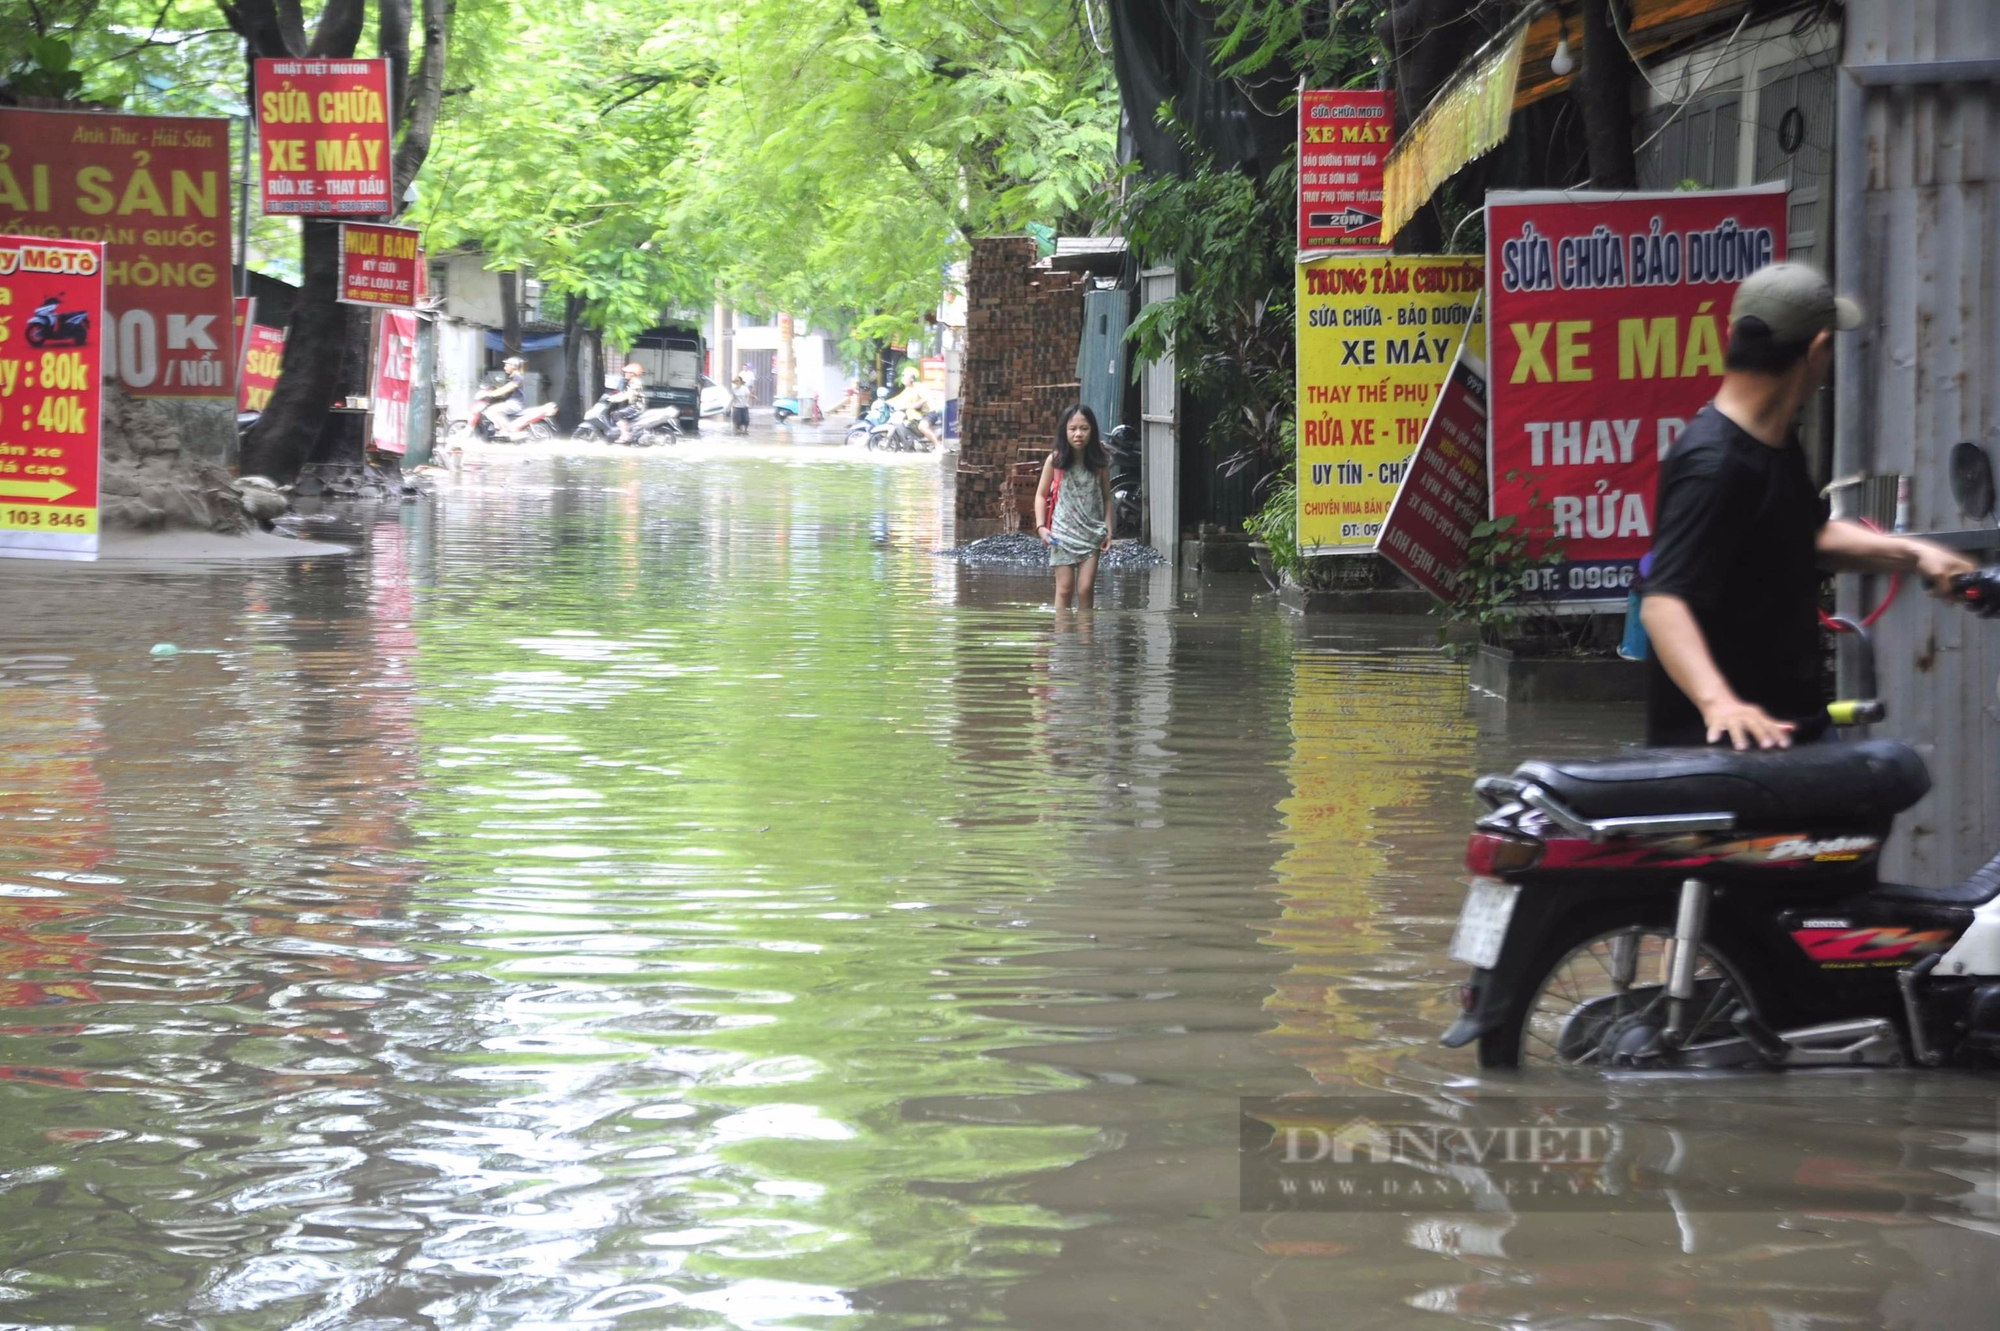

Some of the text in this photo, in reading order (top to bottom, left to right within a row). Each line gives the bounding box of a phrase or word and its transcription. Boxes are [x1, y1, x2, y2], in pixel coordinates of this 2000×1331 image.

[330, 63, 369, 74] MOTOR
[262, 81, 385, 123] SỬA CHỮA
[1357, 107, 1383, 118] MOTO
[1305, 121, 1392, 143] XE MÁY
[267, 133, 382, 171] XE MÁY
[1344, 156, 1360, 166] THAY
[0, 144, 217, 218] ẢI SẢN
[268, 175, 294, 195] RỬA
[297, 180, 315, 195] XE
[325, 180, 356, 195] THAY
[359, 175, 386, 195] DẦU
[1318, 174, 1328, 184] XE
[1303, 191, 1320, 202] THAY
[1330, 215, 1364, 225] 20M
[142, 224, 217, 247] QUỐC
[345, 231, 416, 260] MUA BÁN
[1502, 216, 1773, 292] SỬA CHỮA BẢO DƯỠNG
[106, 254, 217, 288] HÒNG
[348, 274, 368, 287] CÁC
[396, 280, 409, 291] XE
[1306, 267, 1367, 295] TRUNG
[1371, 259, 1409, 294] TÂM
[1309, 304, 1338, 327] SỬA
[1343, 304, 1382, 326] CHỮA
[1397, 302, 1427, 325] BẢO
[1432, 303, 1482, 325] DƯỠNG
[1341, 331, 1450, 365] XE MÁY
[1509, 301, 1733, 384] XE MÁ
[40, 351, 88, 390] 80k
[1307, 386, 1351, 403] THAY
[1357, 376, 1390, 402] THẾ
[1393, 385, 1428, 407] PHỤ
[37, 395, 86, 434] 40k
[1305, 410, 1344, 446] RỬA
[1351, 419, 1375, 446] XE
[0, 443, 63, 458] án xe
[1524, 418, 1641, 466] THAY
[0, 460, 67, 476] iá cao
[1312, 463, 1332, 485] UY
[1337, 459, 1362, 484] TÍN
[1342, 501, 1361, 514] MUA
[1365, 497, 1382, 514] BÁN
[1407, 491, 1421, 511] XE
[1441, 487, 1456, 506] XE
[8, 510, 86, 527] 103 846
[1553, 479, 1650, 539] RỬA
[1342, 524, 1360, 537] ĐT:
[1568, 566, 1634, 590] 0966
[1802, 920, 1851, 928] HONDA
